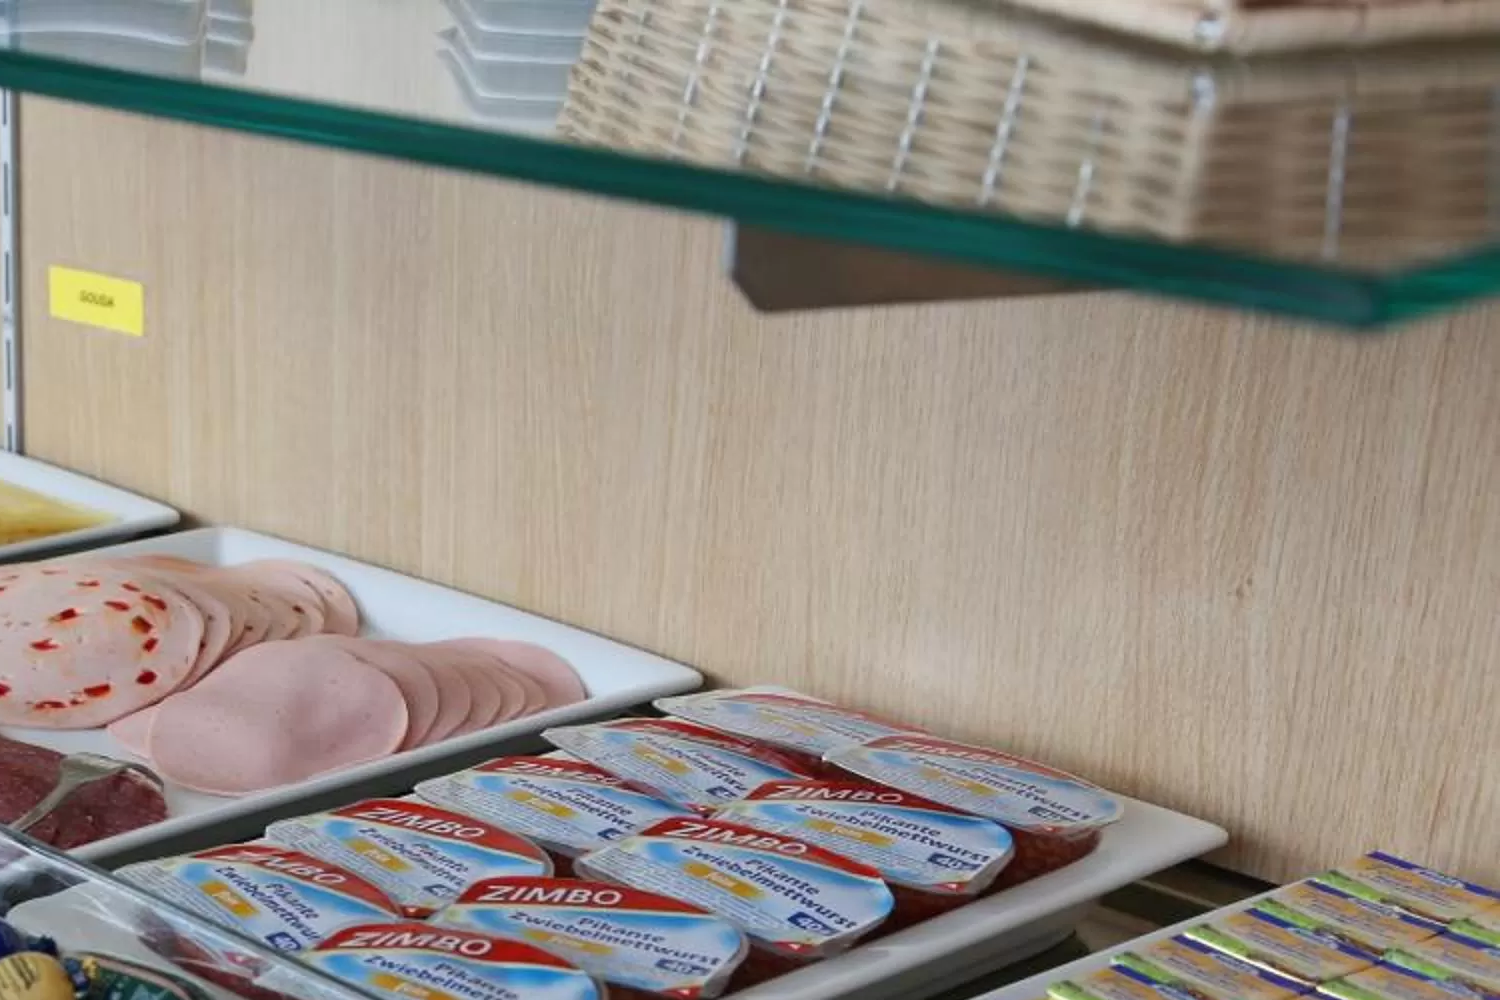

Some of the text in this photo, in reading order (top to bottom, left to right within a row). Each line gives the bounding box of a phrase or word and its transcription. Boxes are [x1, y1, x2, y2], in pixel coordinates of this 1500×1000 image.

[766, 784, 904, 803] ZIMBO
[353, 807, 486, 839] ZIMBO
[661, 821, 808, 855] ZIMBO
[796, 804, 991, 863] Zwiebelmettwurst
[859, 810, 942, 838] Pikante
[683, 845, 858, 929] Zwiebelmettwurst
[745, 858, 820, 895] Pikante
[477, 885, 623, 906] ZIMBO
[339, 931, 493, 956] ZIMBO
[507, 911, 722, 966] Zwiebelmettwurst
[576, 916, 666, 944] Pikante
[434, 963, 519, 1000] Pikante
